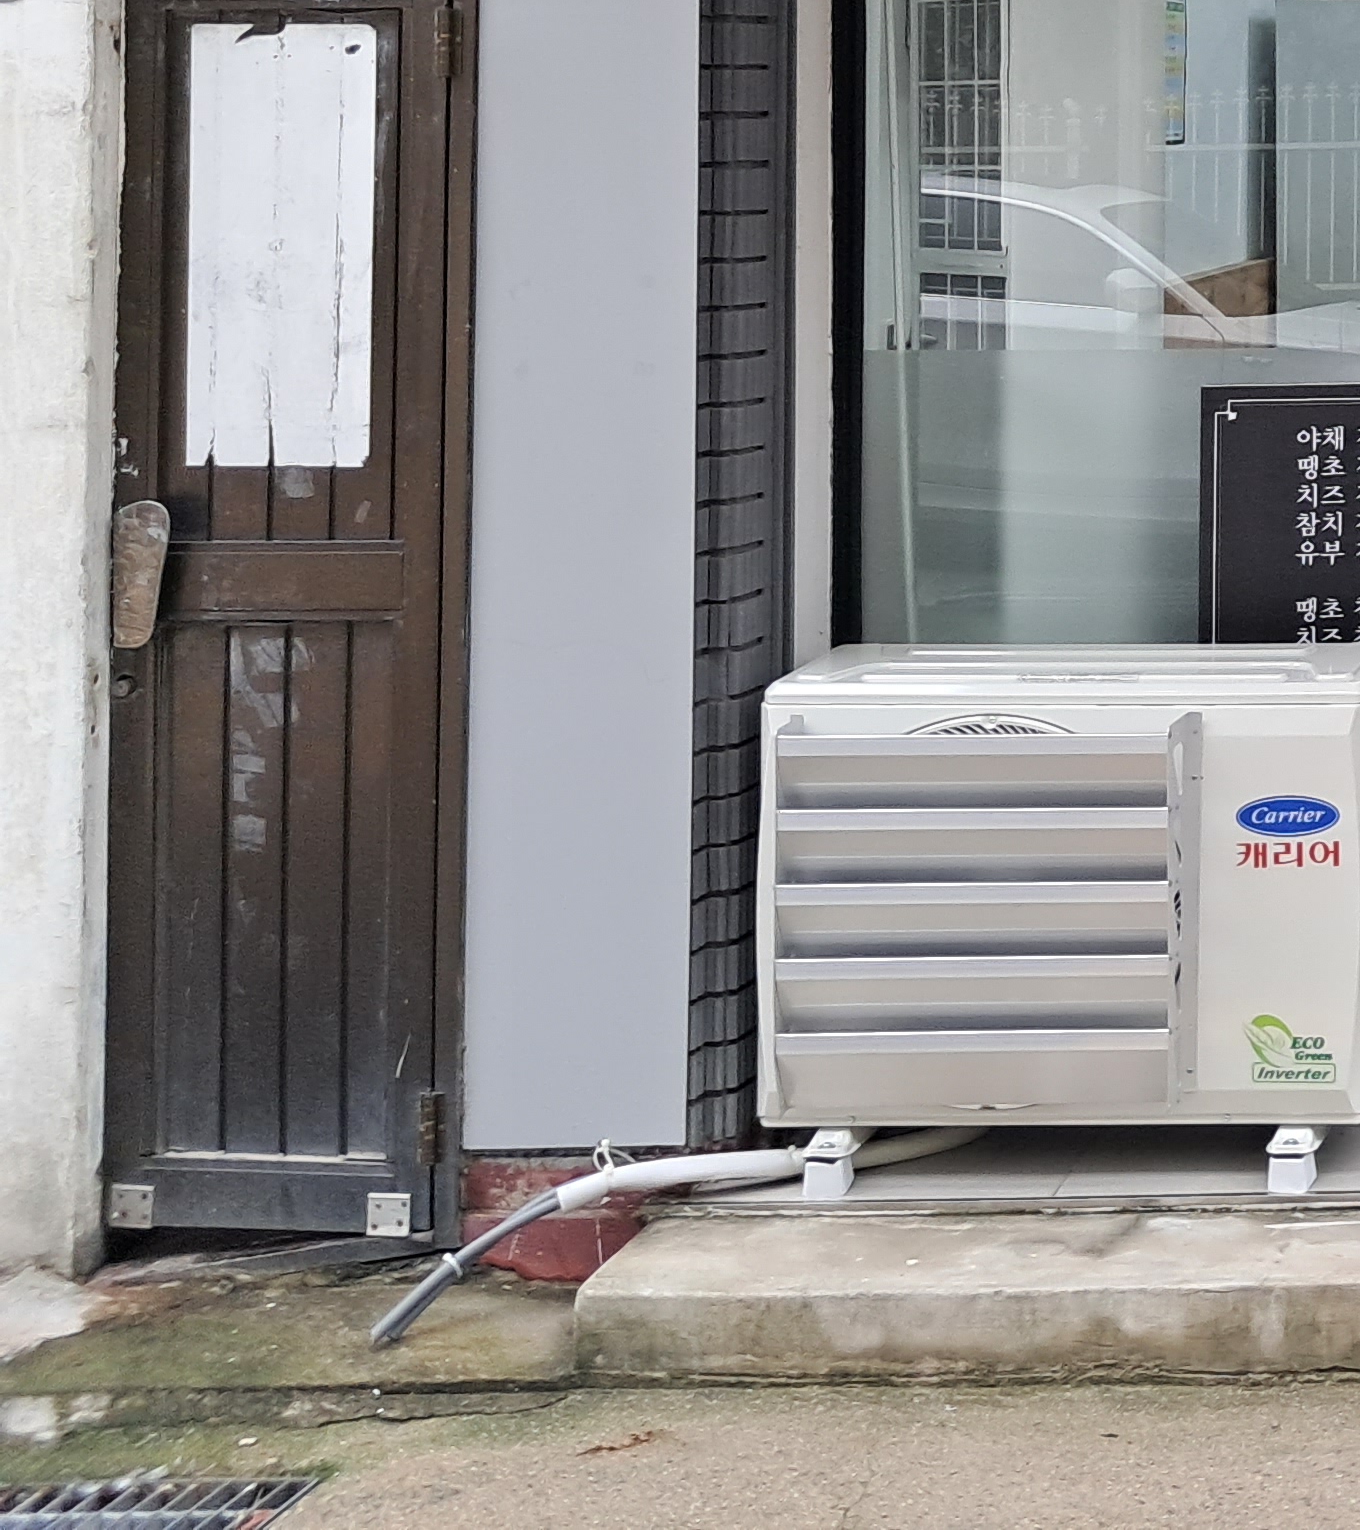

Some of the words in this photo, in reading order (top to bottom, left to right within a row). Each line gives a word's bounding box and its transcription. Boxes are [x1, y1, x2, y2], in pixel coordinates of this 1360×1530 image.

[1296, 425, 1345, 452] 야채
[1297, 454, 1346, 480] 땡초
[1296, 482, 1346, 509] 치즈
[1295, 510, 1343, 537] 참치
[1295, 540, 1345, 566] 유부
[1295, 596, 1344, 623] 땡초
[1251, 807, 1326, 824] Carrier
[1236, 841, 1340, 868] 캐리어
[1290, 1037, 1325, 1049] ECO
[1295, 1051, 1333, 1060] Green
[1258, 1067, 1331, 1079] Inverter
